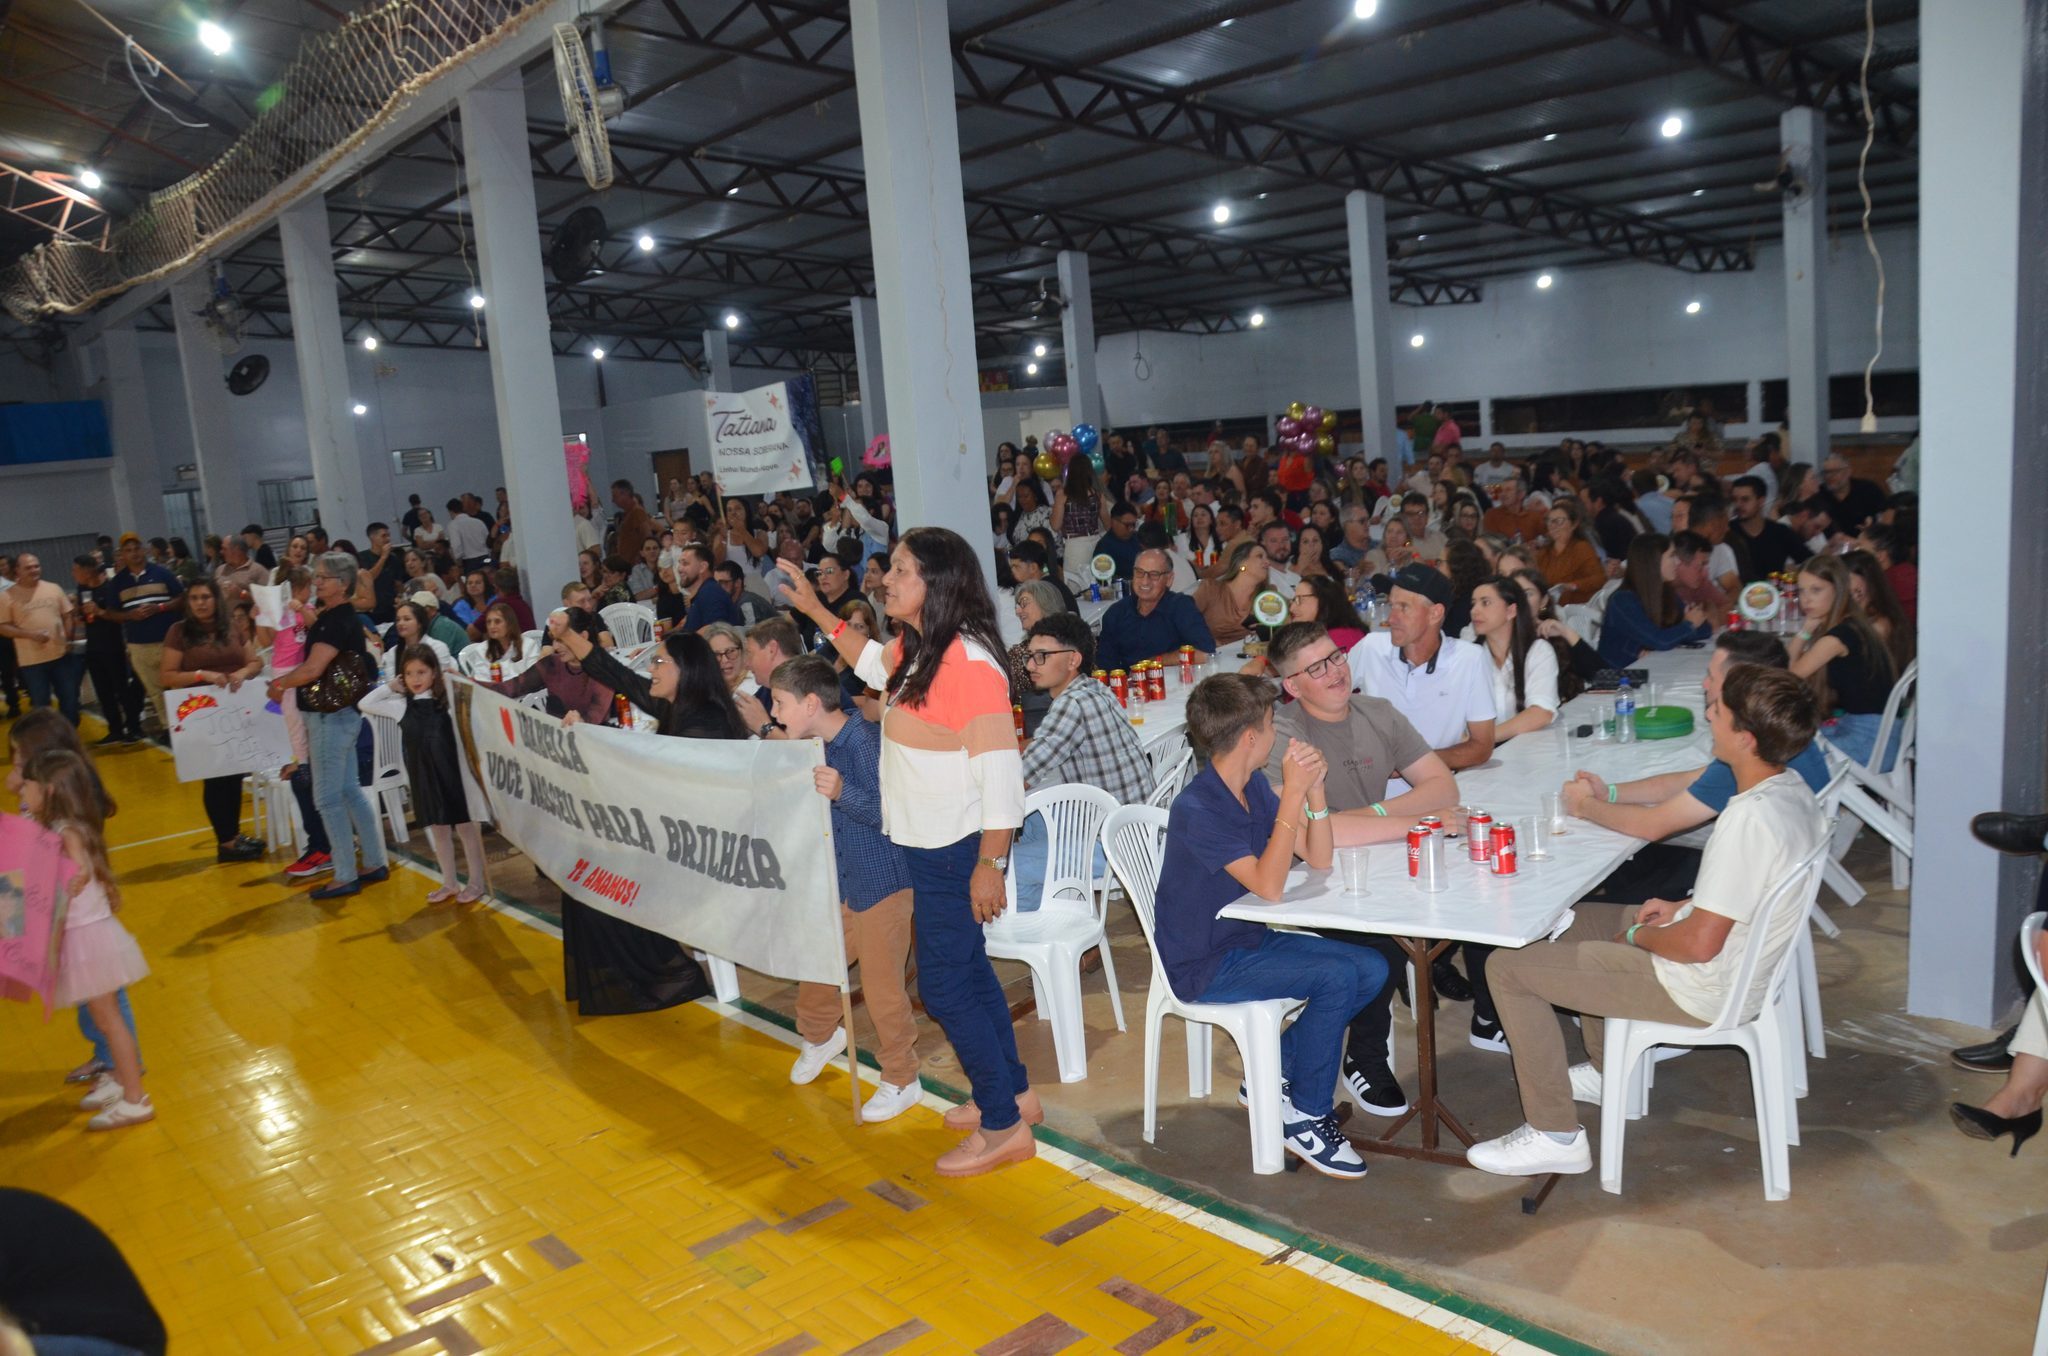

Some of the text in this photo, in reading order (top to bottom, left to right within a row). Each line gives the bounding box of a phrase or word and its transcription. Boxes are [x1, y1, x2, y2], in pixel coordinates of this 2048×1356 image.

[712, 409, 777, 443] Tatiana
[719, 447, 751, 456] NOSSA
[581, 799, 656, 854] PARA
[660, 814, 786, 890] BRILHAR
[566, 858, 641, 908] TE AMAMOS!
